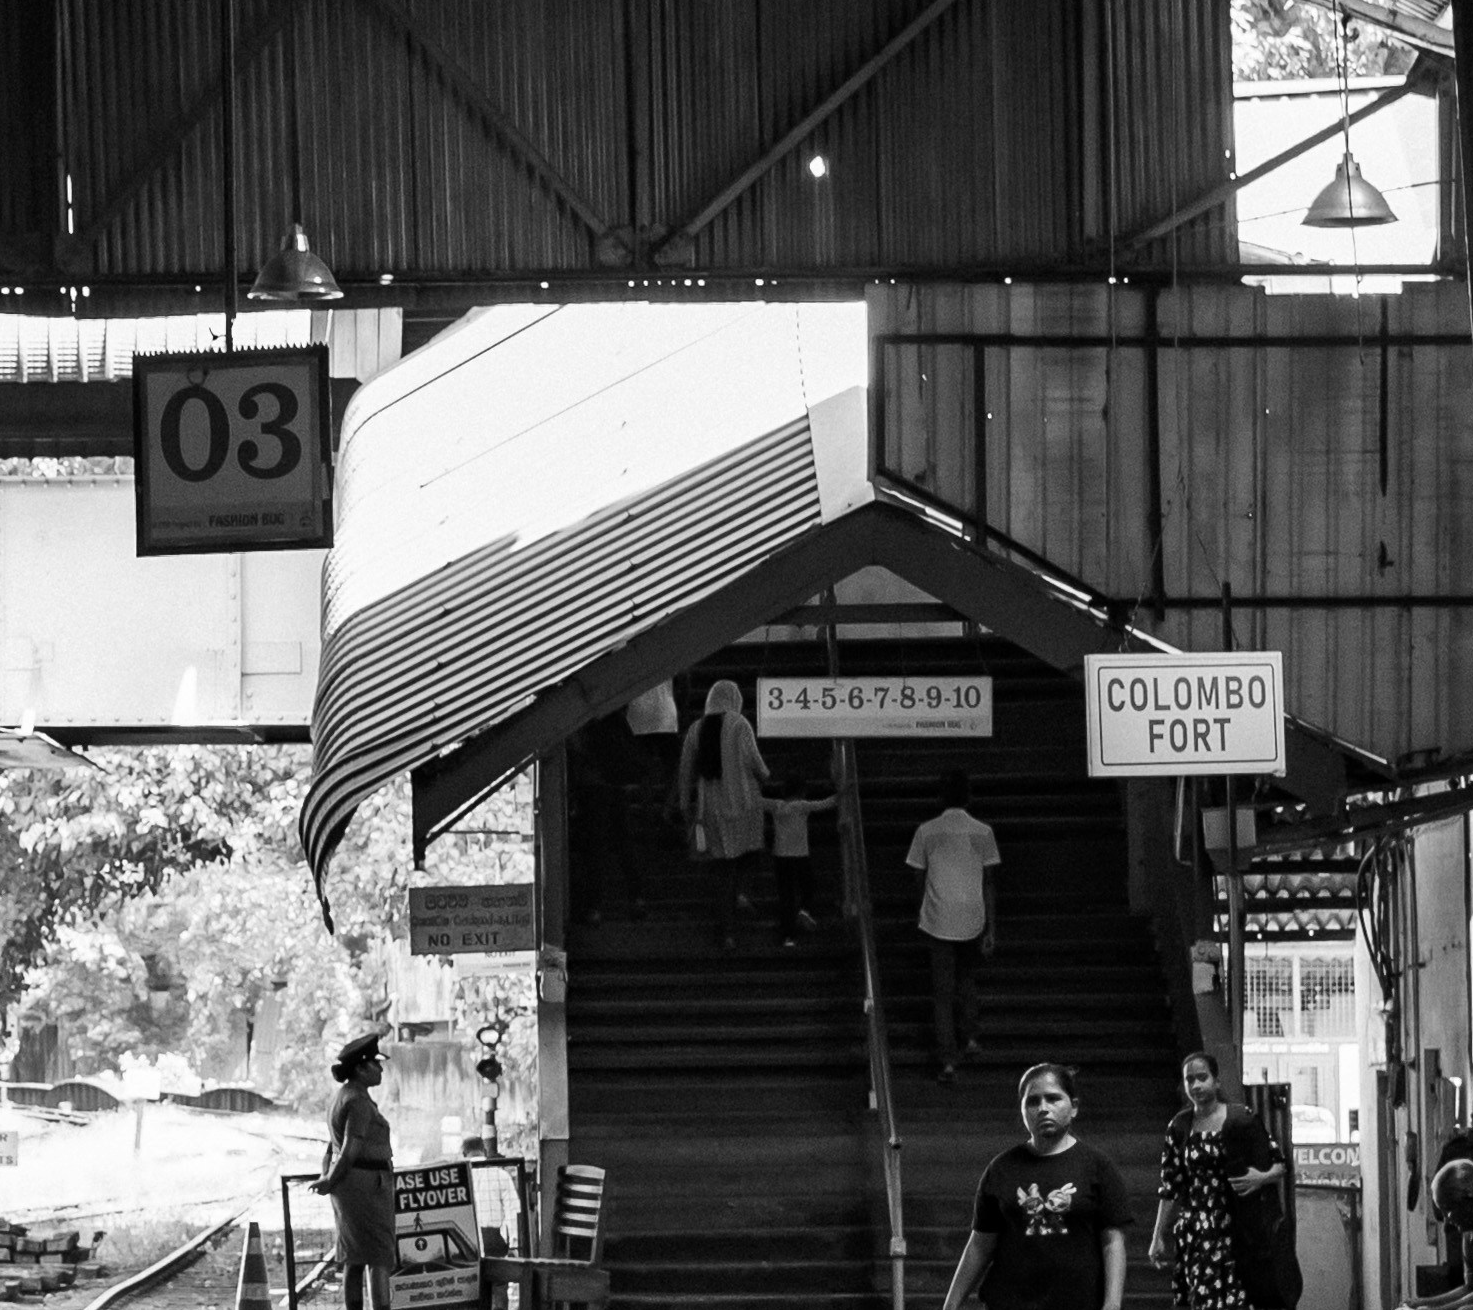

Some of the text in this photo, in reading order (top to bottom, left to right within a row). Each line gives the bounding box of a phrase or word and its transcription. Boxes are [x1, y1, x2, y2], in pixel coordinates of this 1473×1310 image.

[160, 382, 302, 482] 03
[209, 512, 258, 528] FASHION
[261, 511, 286, 526] BUG
[768, 685, 982, 710] 3-4-5-6-7-8-9-10
[1107, 675, 1267, 713] COLOMBO
[1148, 718, 1232, 753] FORT
[428, 932, 500, 948] NO EXIT
[396, 1168, 460, 1191] ASE USE
[399, 1186, 468, 1210] FLYOVER
